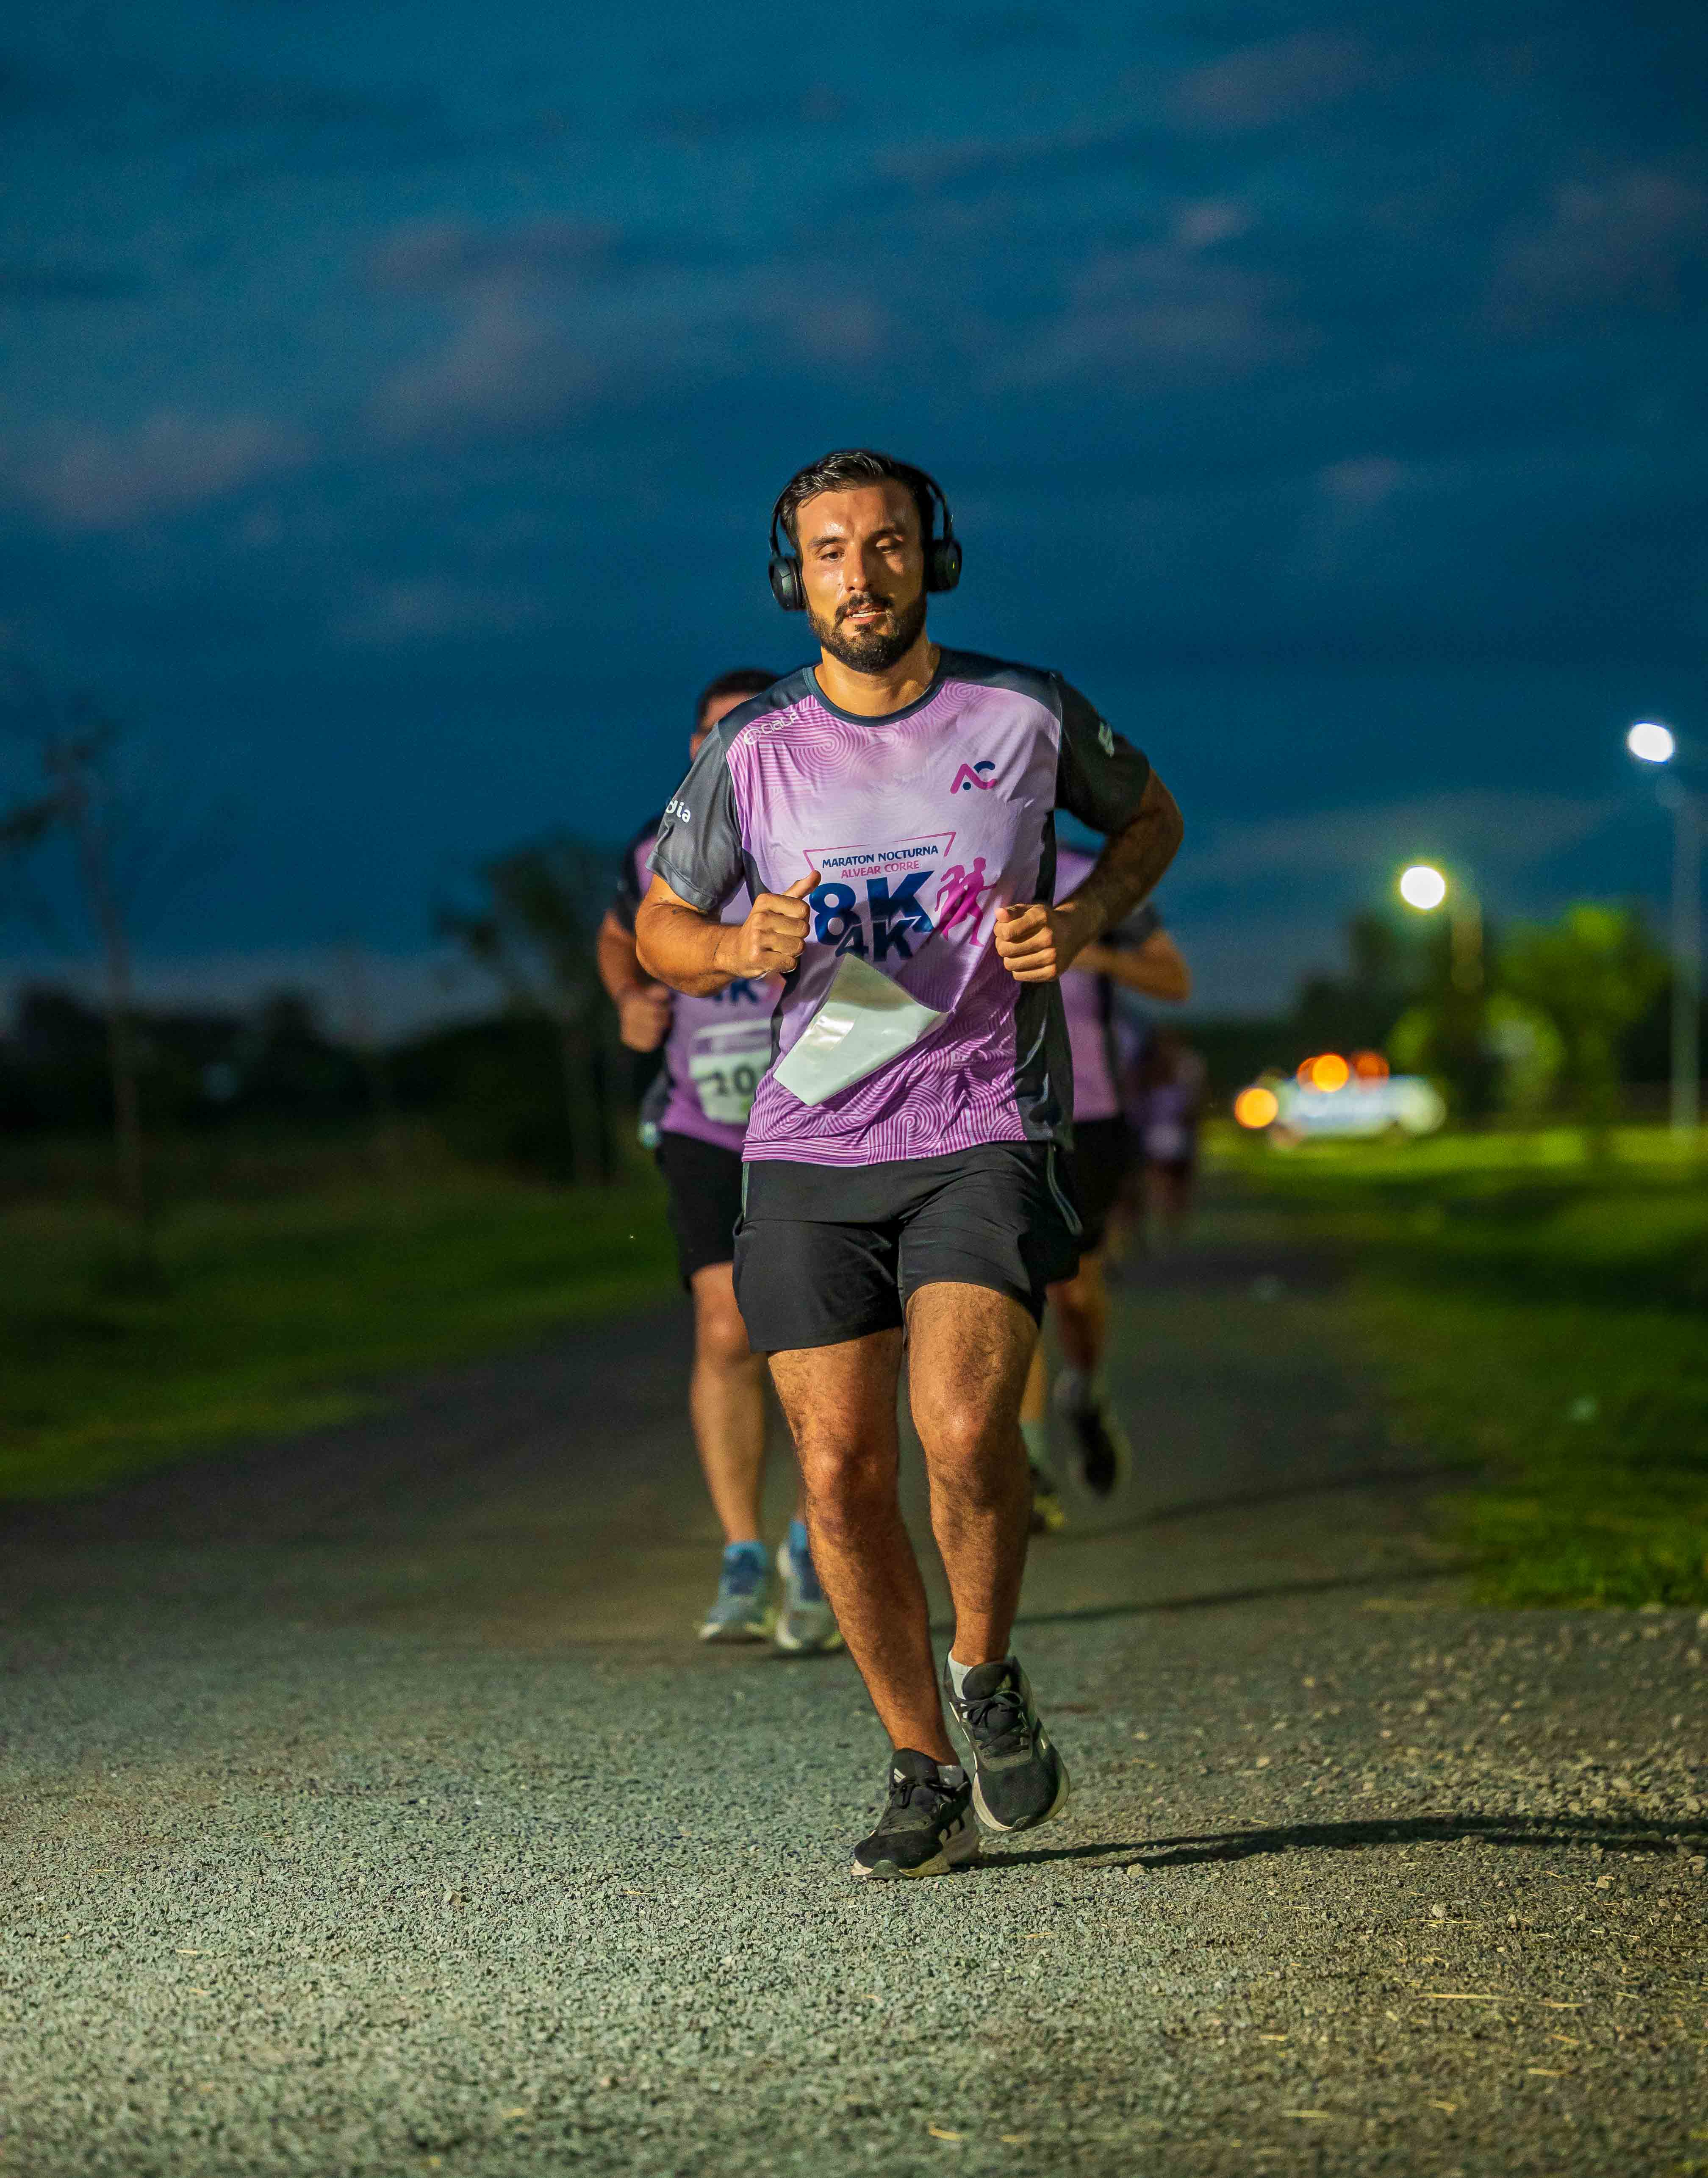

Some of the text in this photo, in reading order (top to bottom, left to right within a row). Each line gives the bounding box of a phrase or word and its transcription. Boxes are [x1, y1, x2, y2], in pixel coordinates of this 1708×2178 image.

[822, 845, 938, 868] MARATON NOCTURNA
[841, 860, 920, 879] ALVEAR CORRE
[809, 870, 935, 945] 8K
[835, 916, 914, 962] 4K
